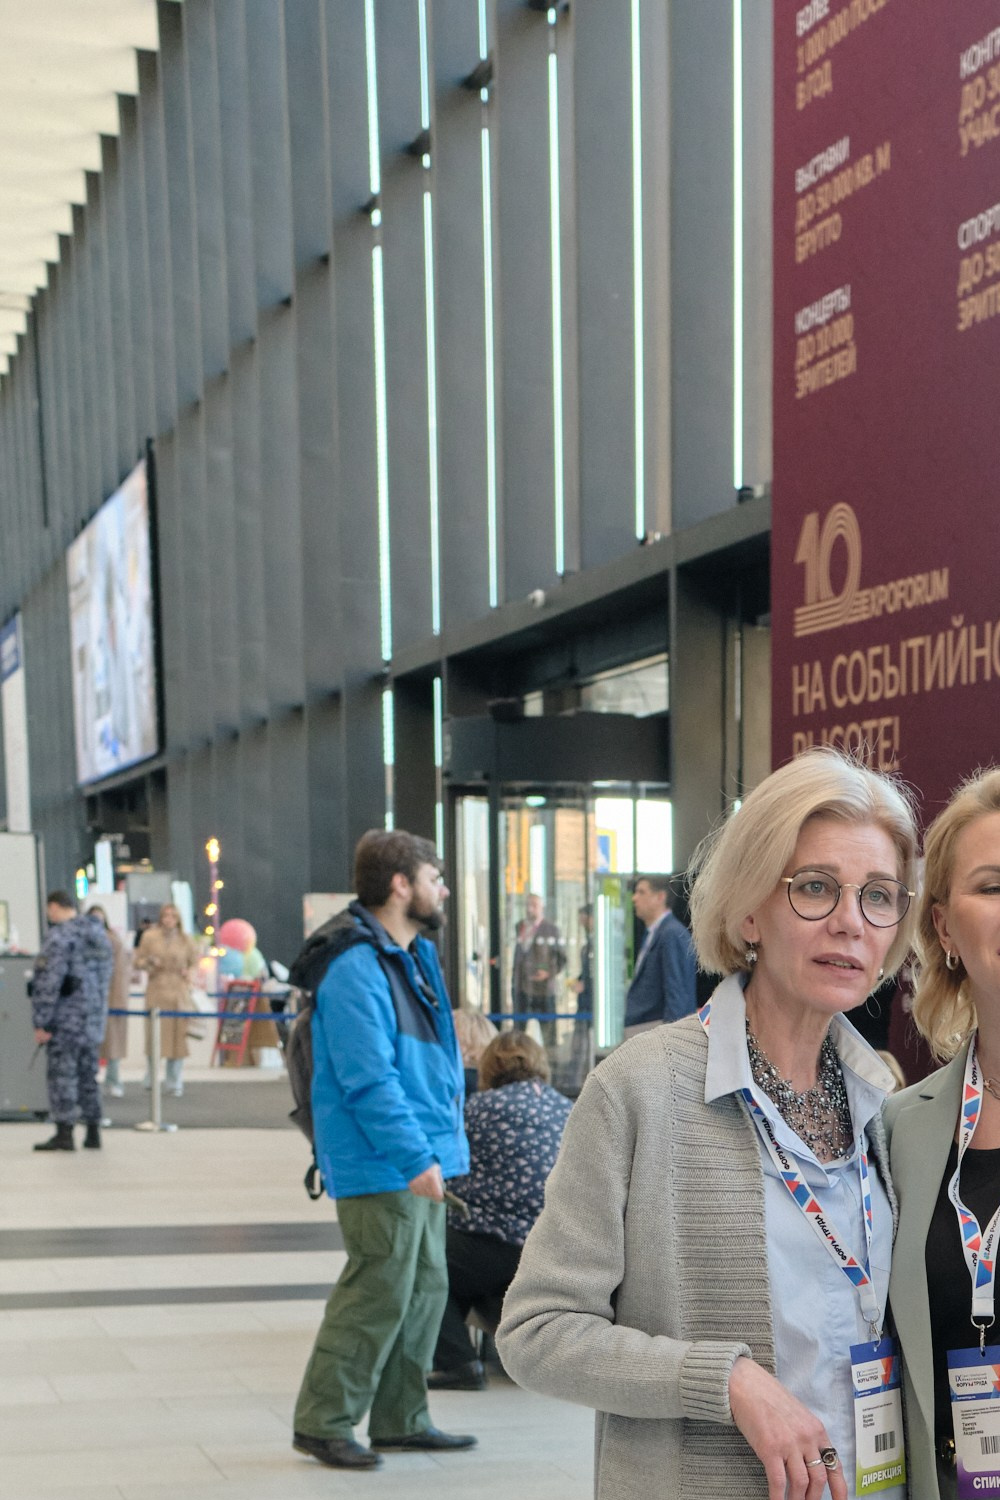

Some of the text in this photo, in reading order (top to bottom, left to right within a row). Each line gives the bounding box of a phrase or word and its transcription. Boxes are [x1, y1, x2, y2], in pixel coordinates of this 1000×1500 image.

[805, 59, 832, 104] ГОД
[958, 75, 986, 125] ДО
[795, 136, 850, 193] ВЫСТАВКИ
[795, 212, 842, 263] БРУТТО
[957, 252, 984, 297] ДО
[795, 283, 851, 335] КОНЦЕРТЫ
[795, 334, 815, 371] ДО
[795, 340, 857, 399] ЗРИТЕЛЕЙ
[792, 662, 827, 717] НА
[814, 1214, 831, 1238] ТРУДА
[984, 1233, 994, 1254] Avito
[861, 1464, 902, 1489] ДИРЕКЦИЯ
